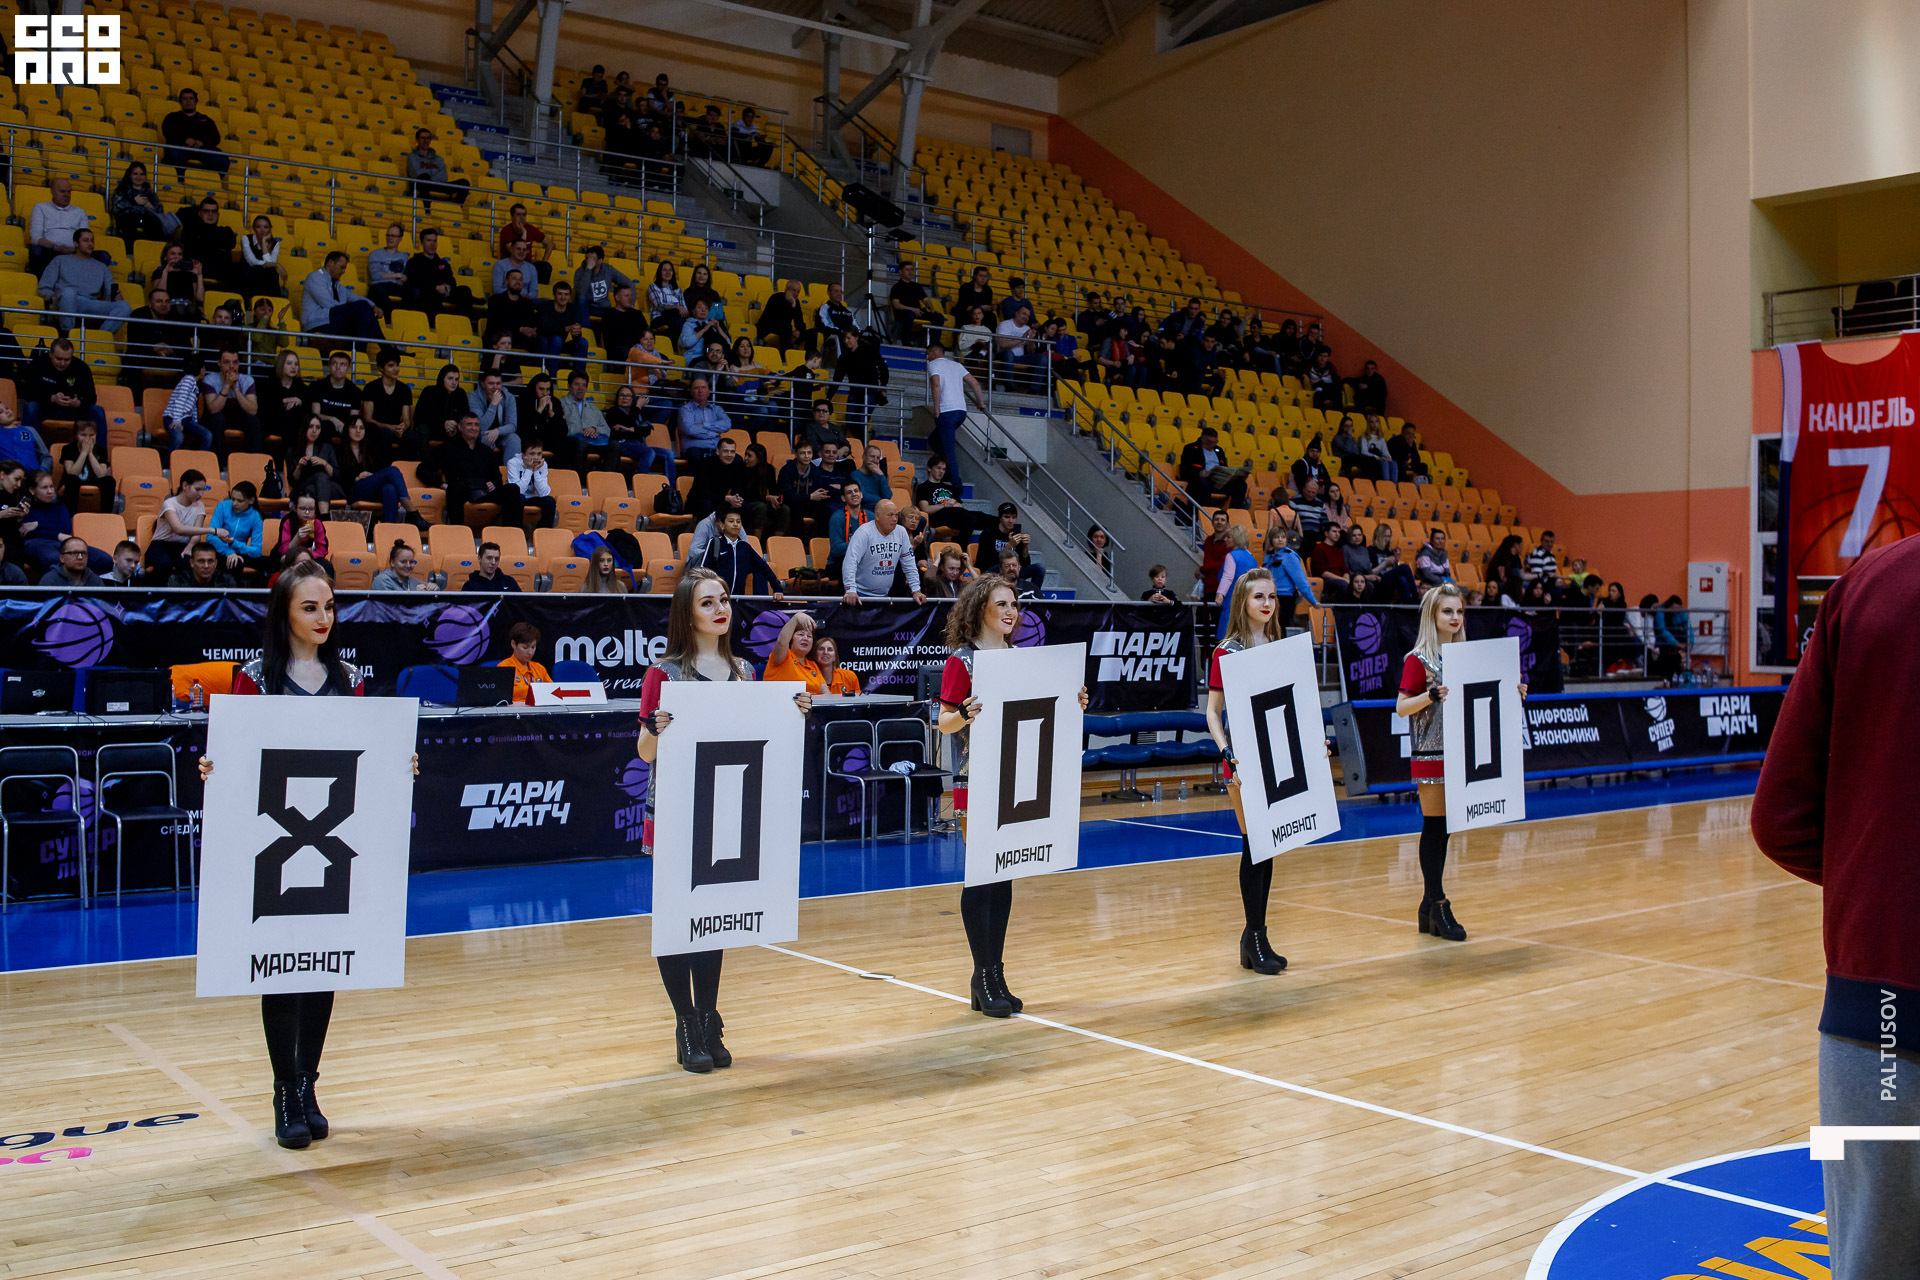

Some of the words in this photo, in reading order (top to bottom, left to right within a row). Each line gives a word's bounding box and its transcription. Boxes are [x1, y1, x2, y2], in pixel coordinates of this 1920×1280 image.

[1809, 396, 1916, 433] КАНДЕЛЬ
[1828, 445, 1891, 558] 7
[870, 542, 902, 555] PERFECT
[555, 630, 668, 667] molte
[894, 632, 915, 641] XXIX
[1090, 632, 1180, 656] ПАРИ
[203, 648, 264, 660] ЧЕМПИО
[853, 646, 914, 656] ЧЕМПИОНАТ
[840, 661, 873, 672] СРЕДИ
[876, 660, 924, 671] МУЖСКИХ
[1097, 657, 1186, 682] МАТЧ
[1350, 653, 1388, 681] СУПЕР
[613, 678, 643, 690] rea
[869, 674, 903, 685] СЕЗОН
[905, 674, 919, 684] 20
[1359, 675, 1382, 695] ЛИГА
[1528, 704, 1589, 727] ЦИФРОВОЙ
[1700, 696, 1751, 717] ПАРИ
[1462, 679, 1502, 788] 0
[1532, 726, 1600, 746] ЭКОНОМИКИ
[1648, 718, 1675, 743] СУПЕР
[1707, 714, 1758, 737] МАТЧ
[488, 734, 543, 744] @russiabasket
[1250, 683, 1309, 810] 0
[1657, 736, 1675, 752] ЛИГА
[997, 696, 1060, 831] 0
[460, 780, 565, 807] ПАРИ
[837, 783, 886, 814] СУР
[467, 802, 571, 830] МАТЧ
[614, 802, 646, 830] СУП
[690, 740, 769, 893] 0
[1466, 799, 1506, 823] MADSHOT
[252, 749, 366, 924] 8
[625, 825, 644, 842] ЛИ
[1272, 813, 1317, 848] MADSHOT
[995, 844, 1053, 874] MADSHOT
[690, 911, 764, 943] MADSHOT
[251, 951, 355, 983] MADSHOT
